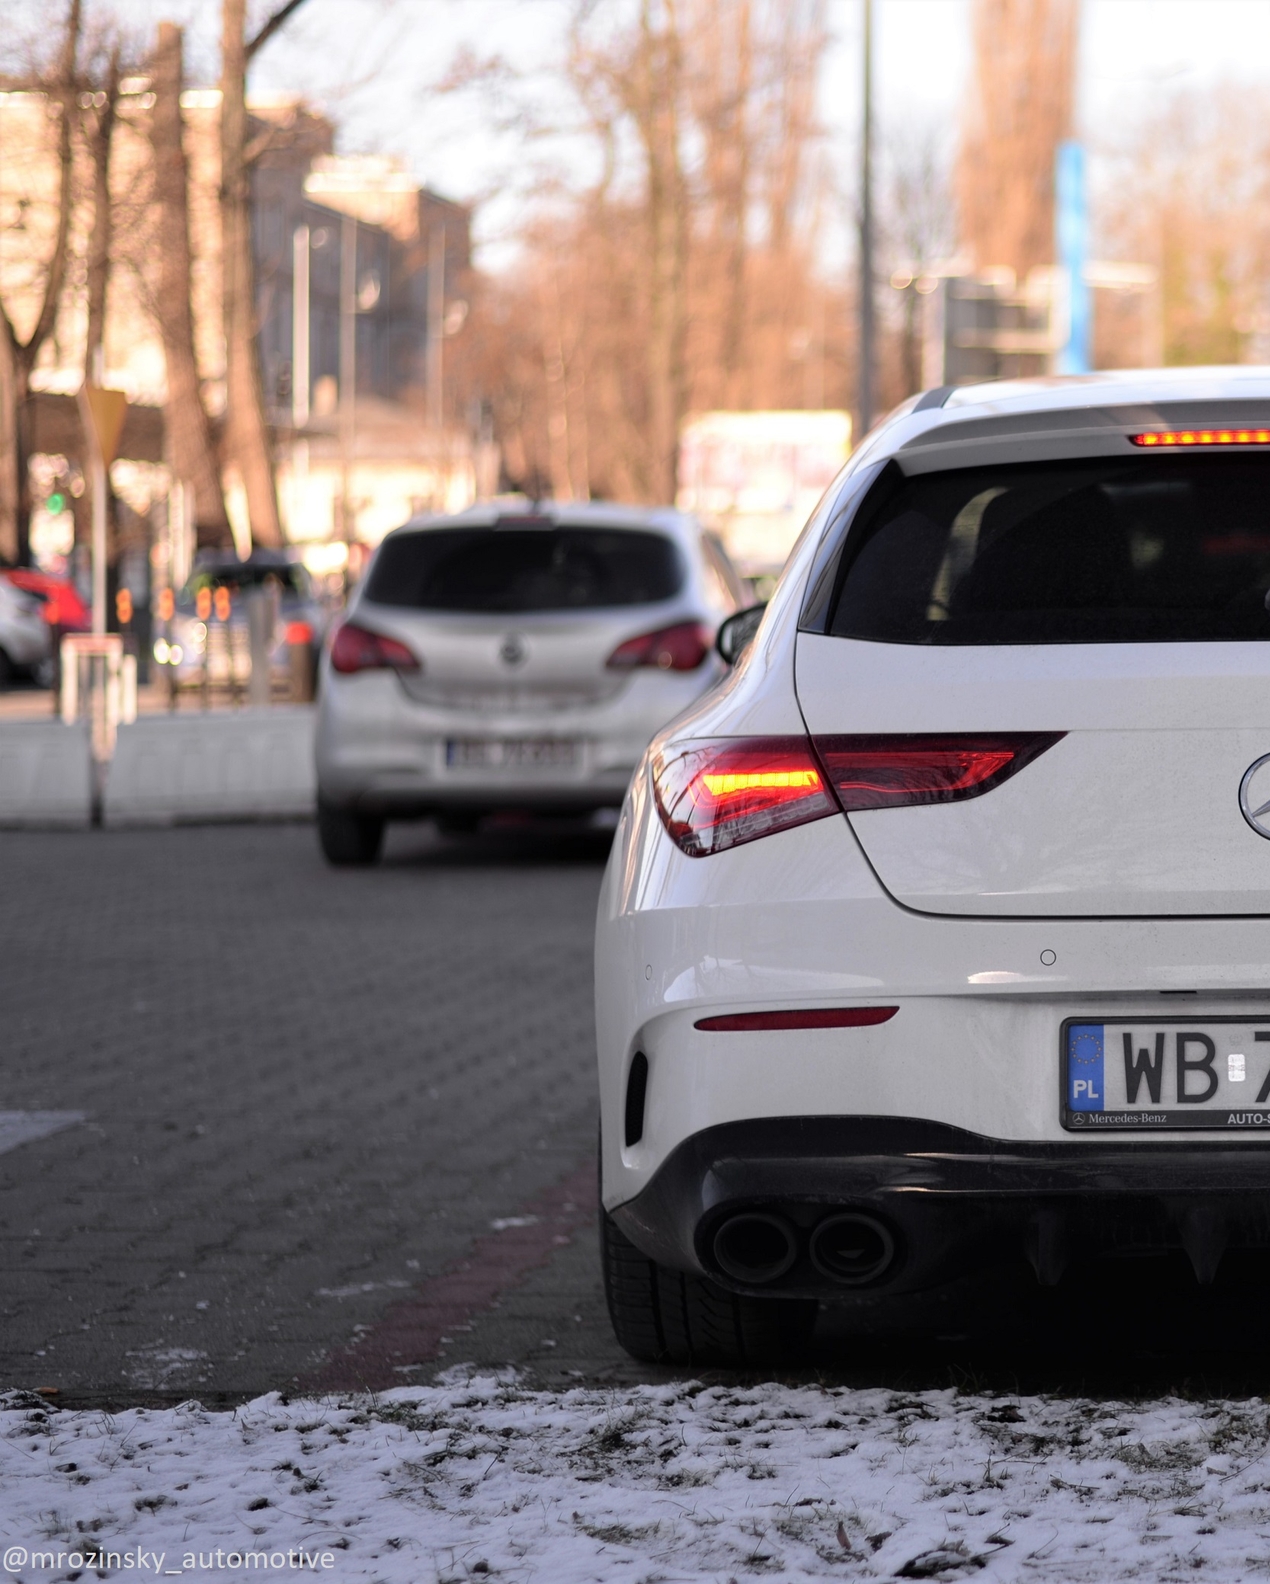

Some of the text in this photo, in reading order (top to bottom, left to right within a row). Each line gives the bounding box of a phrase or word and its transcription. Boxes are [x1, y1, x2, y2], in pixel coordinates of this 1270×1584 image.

[1122, 1032, 1219, 1104] WB
[1073, 1080, 1099, 1099] PL
[1088, 1112, 1167, 1124] Mercedes-Benz
